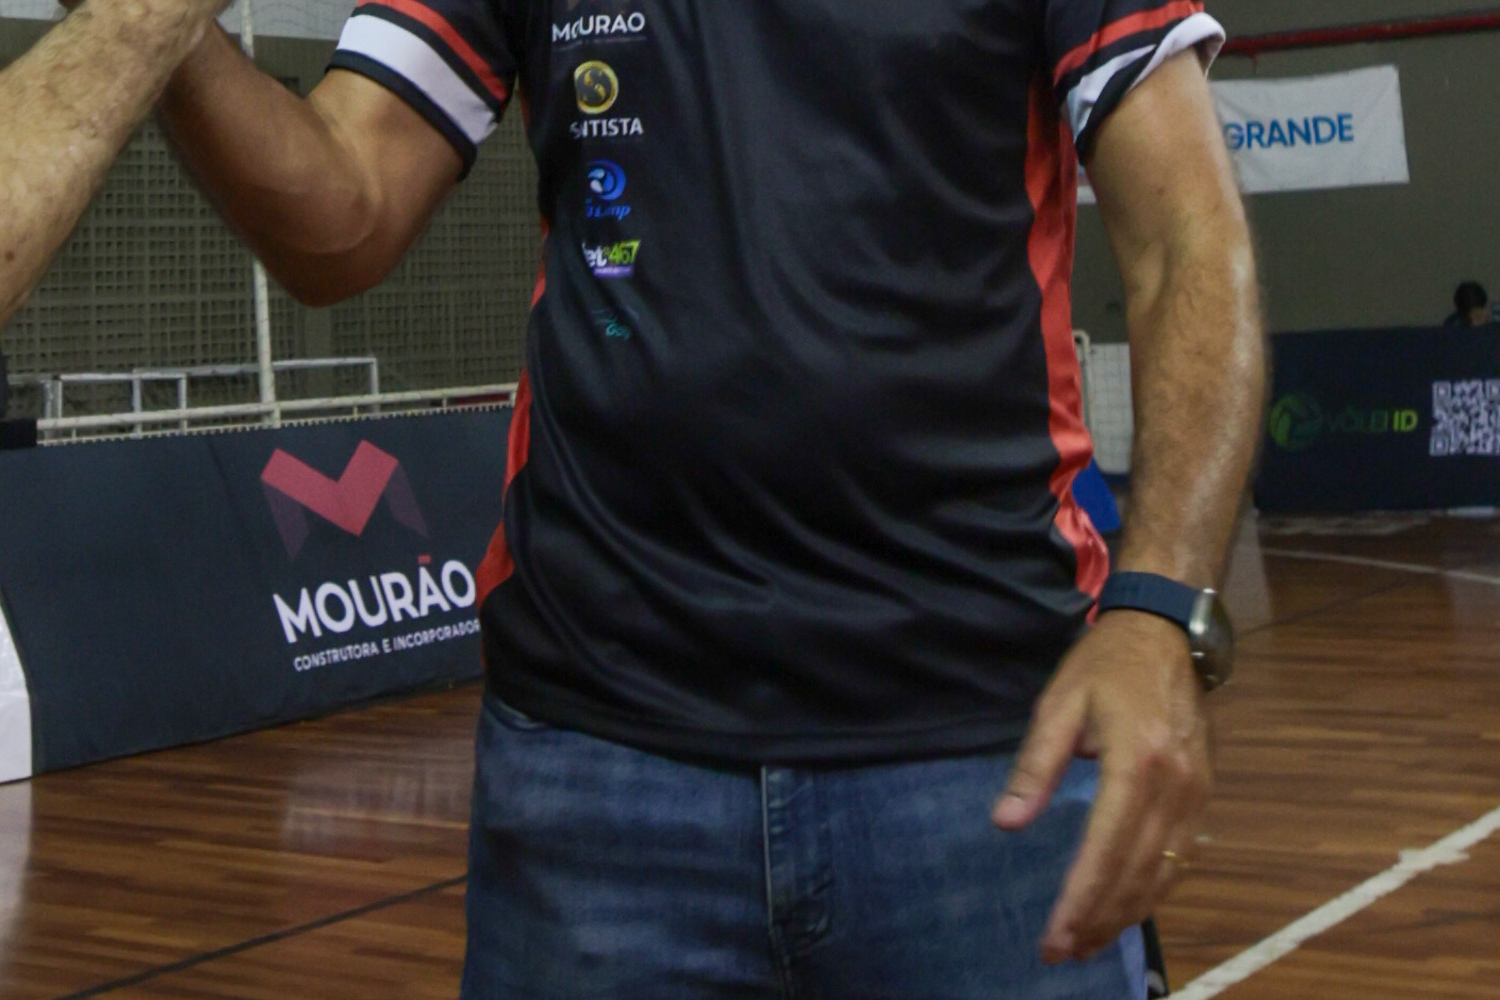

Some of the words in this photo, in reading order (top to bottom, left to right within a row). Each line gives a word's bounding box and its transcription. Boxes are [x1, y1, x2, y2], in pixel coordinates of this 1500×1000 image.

[1224, 112, 1354, 151] GRANDE
[1392, 408, 1419, 433] ID
[293, 641, 380, 673] CONSTRUTORA
[381, 637, 393, 654] E
[392, 617, 482, 652] INCORPORADOR
